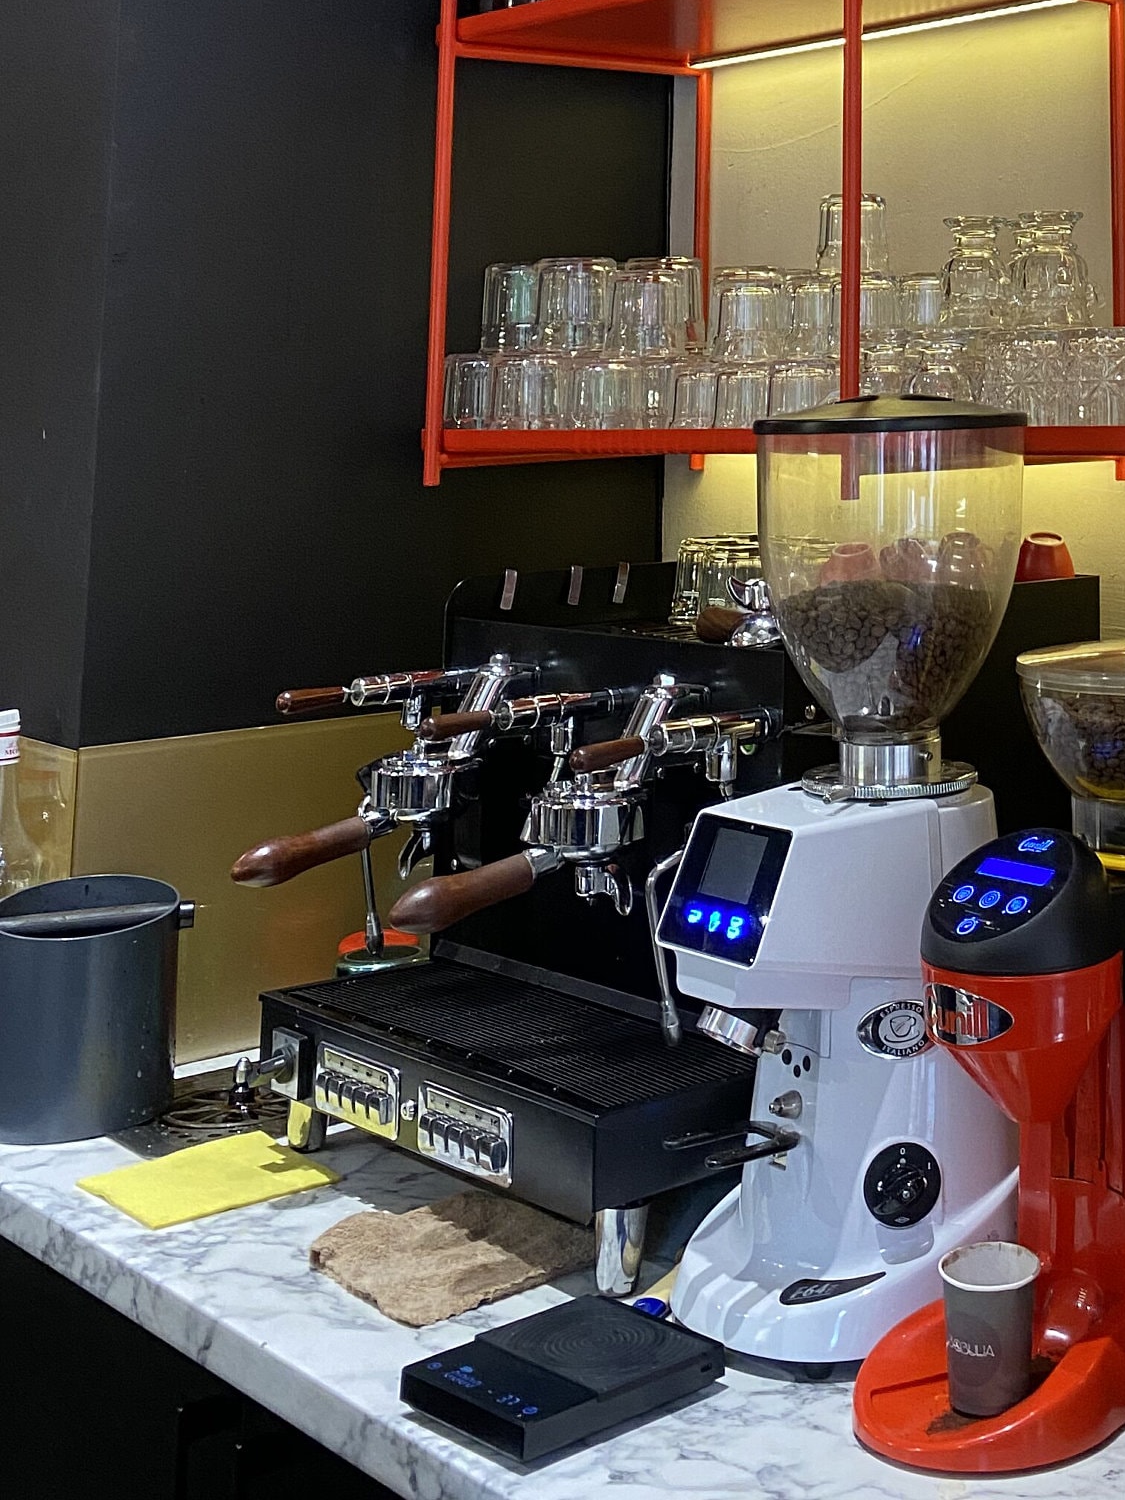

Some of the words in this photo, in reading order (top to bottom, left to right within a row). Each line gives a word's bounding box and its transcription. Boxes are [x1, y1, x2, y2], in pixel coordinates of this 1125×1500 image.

[880, 1002, 923, 1018] ESPRESSO
[882, 1040, 925, 1056] ITALIANO
[900, 1147, 906, 1155] 0
